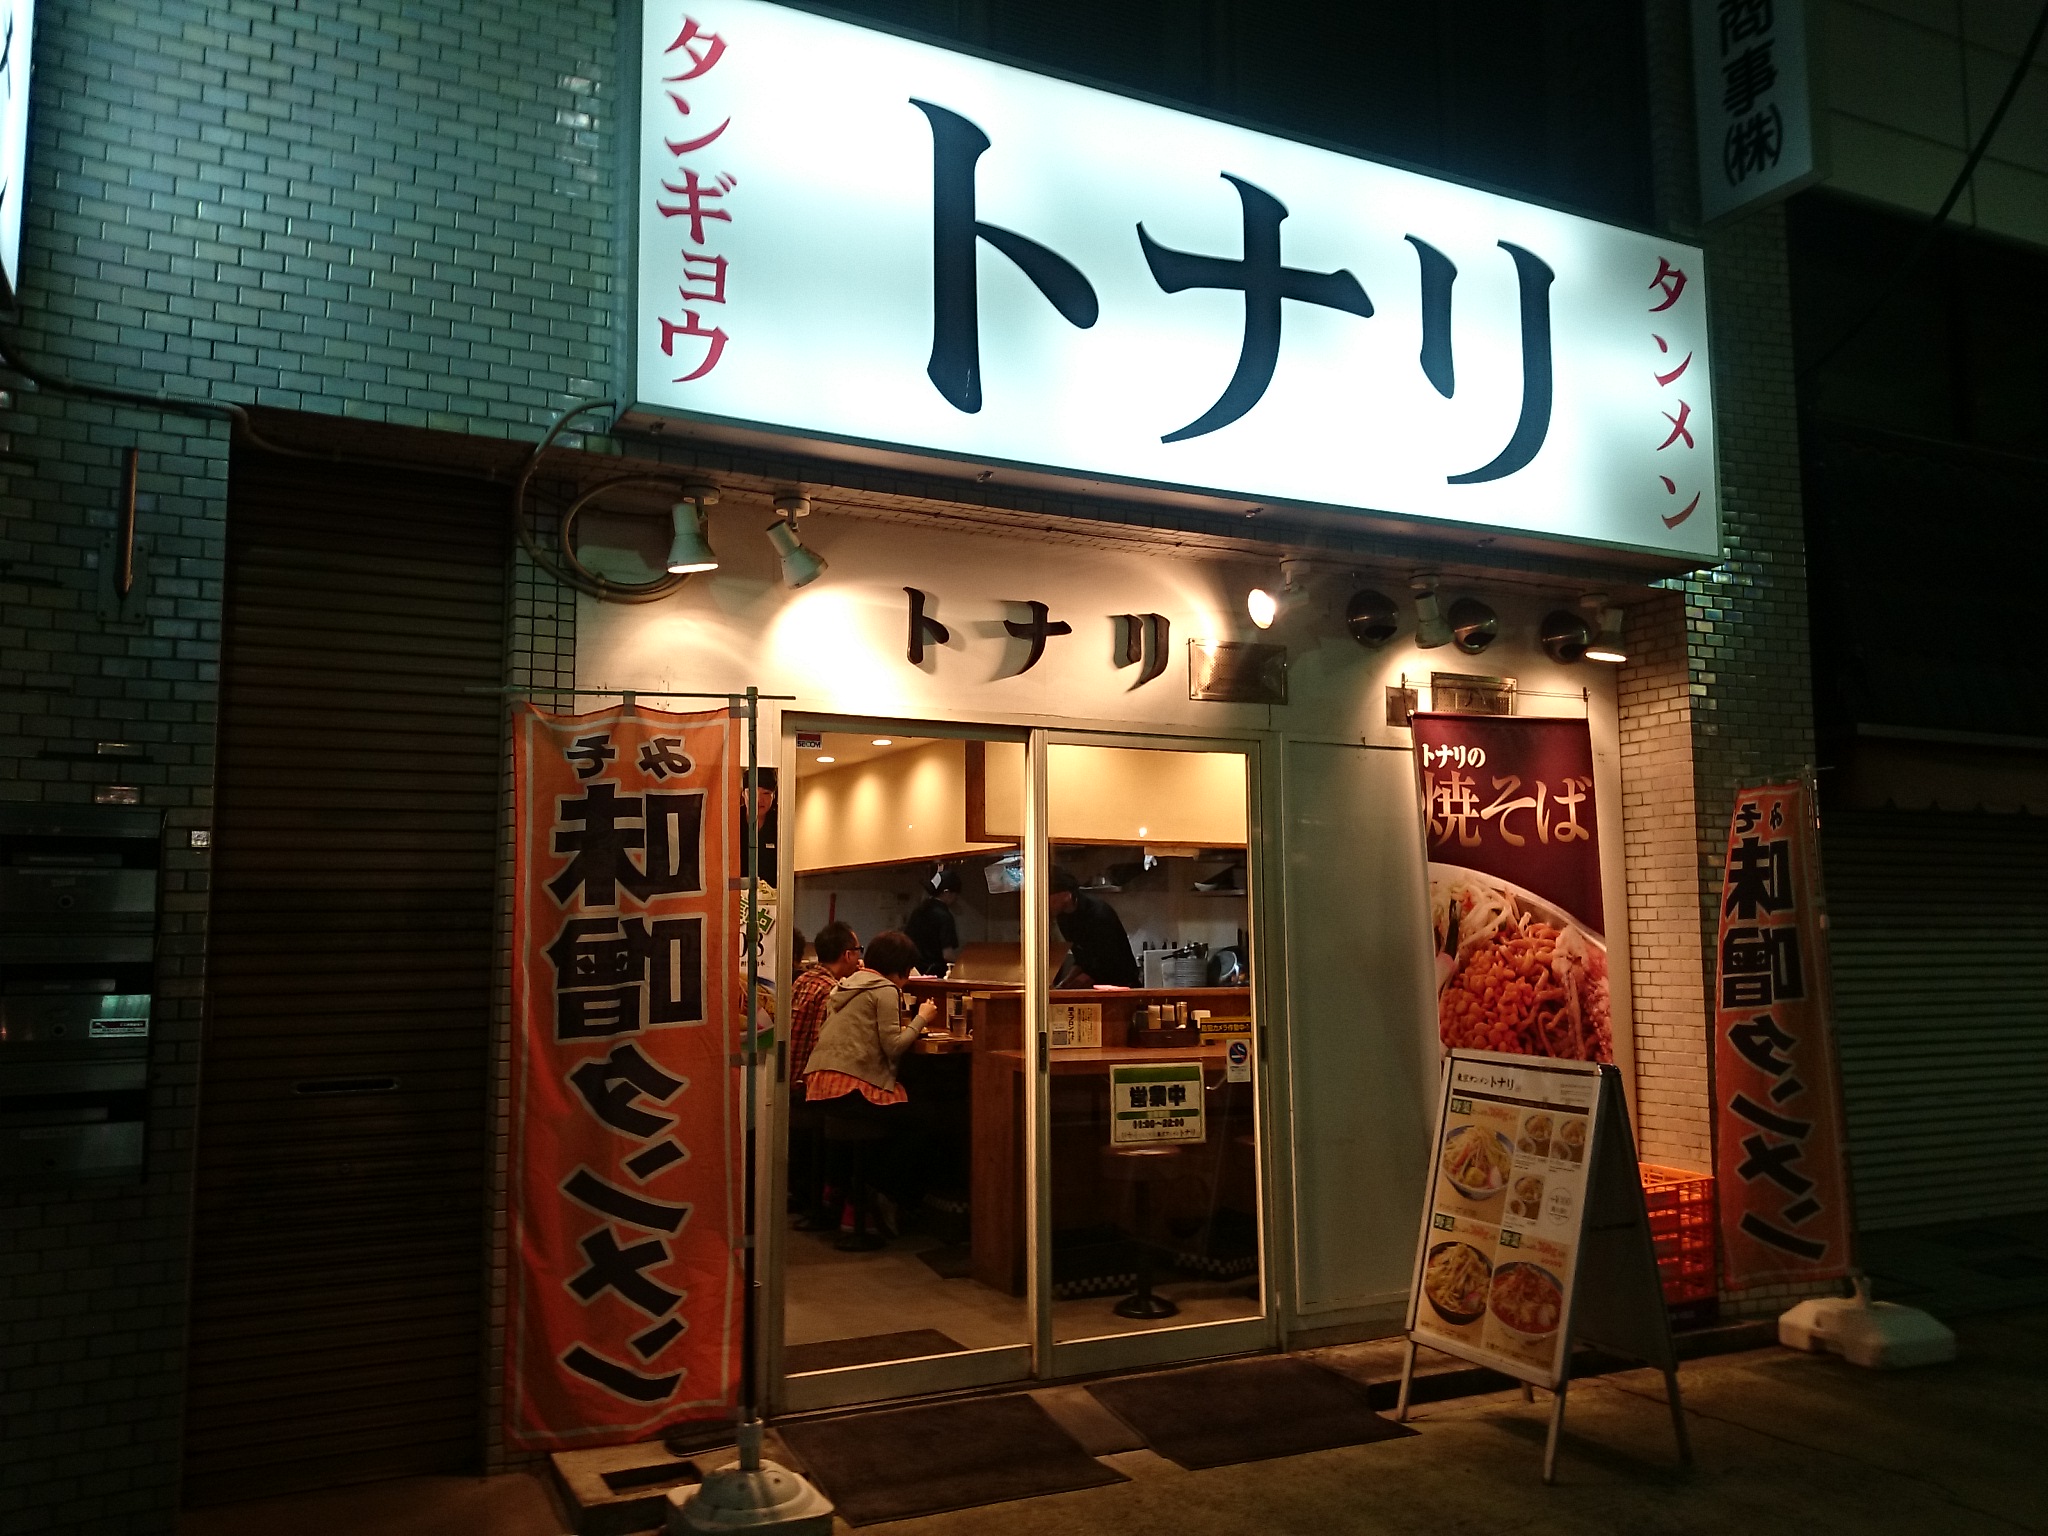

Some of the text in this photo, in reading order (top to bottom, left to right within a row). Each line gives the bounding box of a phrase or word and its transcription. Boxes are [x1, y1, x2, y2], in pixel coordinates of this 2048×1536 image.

[656, 15, 738, 383] タンギョウ
[908, 96, 1556, 485] トナリ
[1648, 255, 1701, 530] タンメン
[903, 586, 1170, 691] トナリ
[797, 740, 821, 748] SECOM
[1421, 743, 1486, 769] トナリの
[1422, 770, 1593, 847] 焼そば
